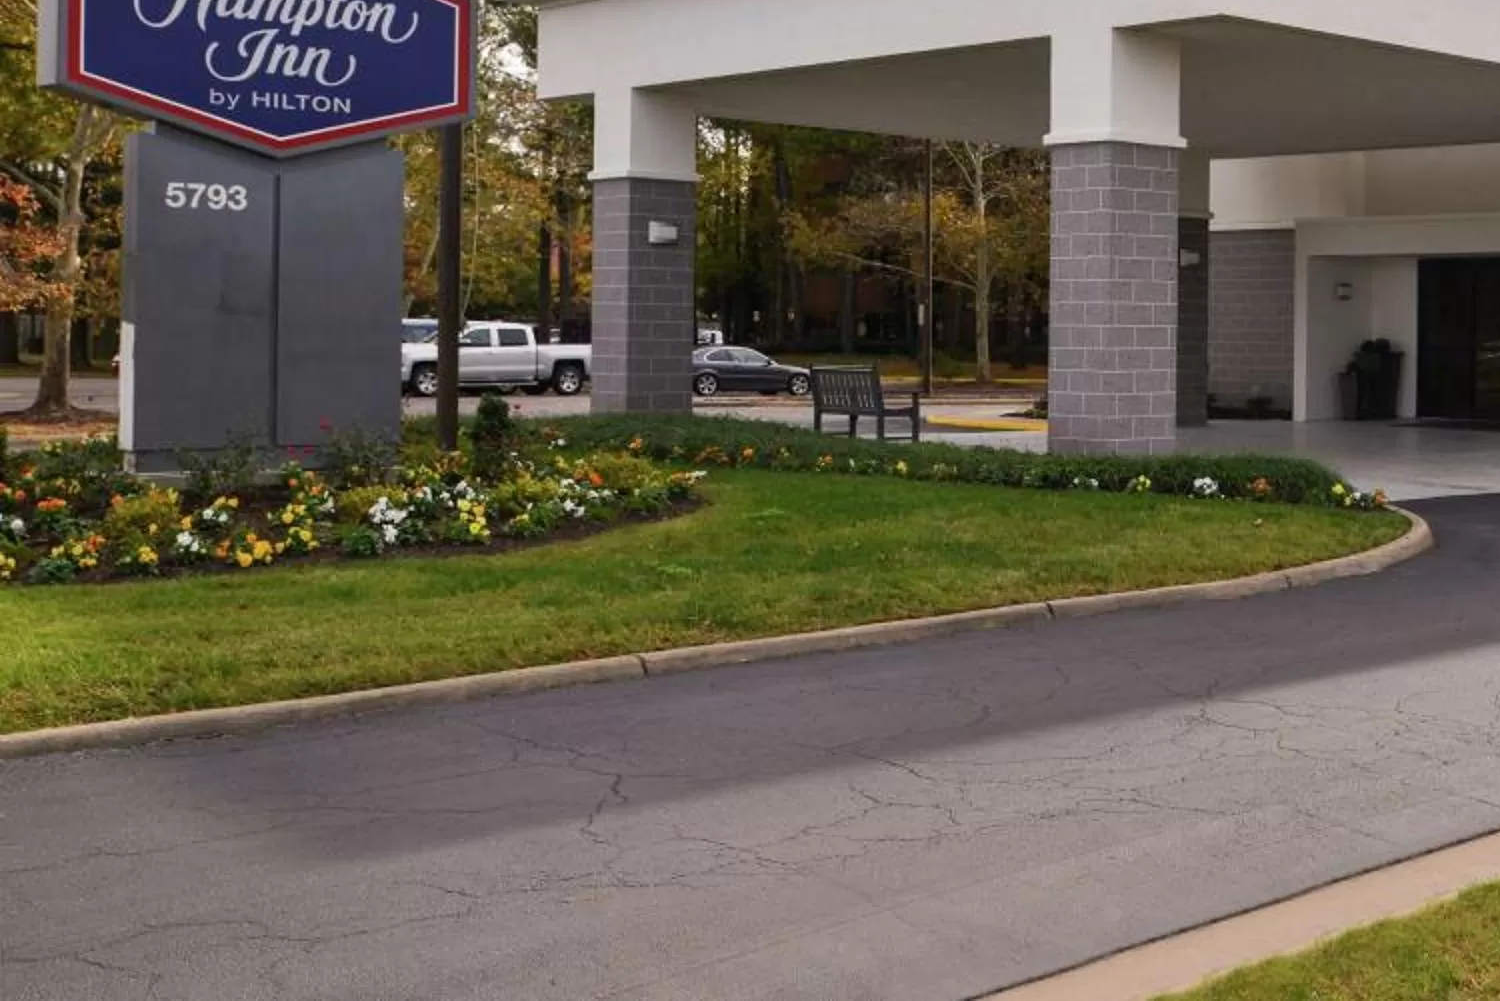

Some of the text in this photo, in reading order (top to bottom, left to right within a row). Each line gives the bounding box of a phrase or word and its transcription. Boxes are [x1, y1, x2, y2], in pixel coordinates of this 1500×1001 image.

[205, 29, 356, 86] Inn
[209, 87, 351, 114] by HILTON
[164, 182, 249, 212] 5793
